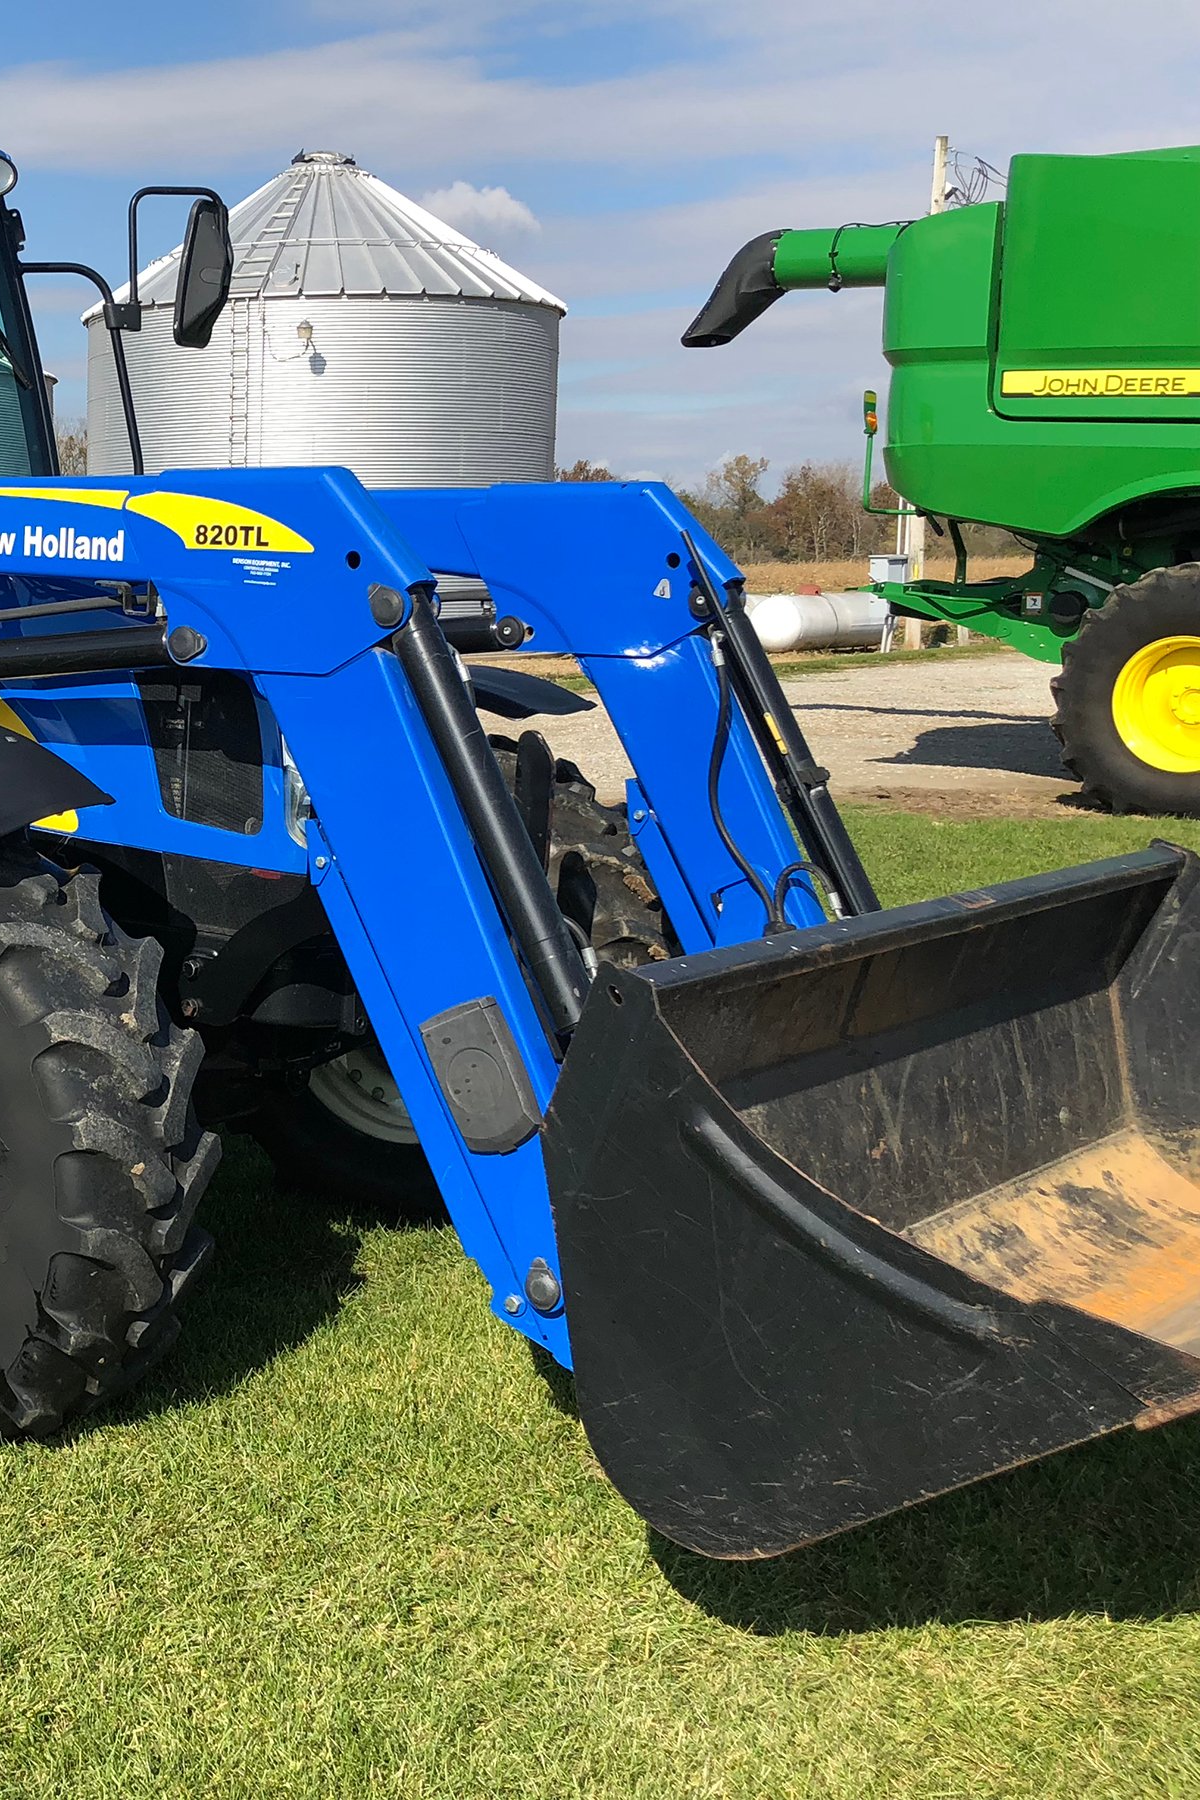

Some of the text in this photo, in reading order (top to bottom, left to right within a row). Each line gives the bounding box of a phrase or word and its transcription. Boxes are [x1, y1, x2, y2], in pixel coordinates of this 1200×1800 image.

[1034, 375, 1186, 393] JOHN DEERE
[24, 526, 124, 562] Holland
[194, 525, 270, 547] 820TL
